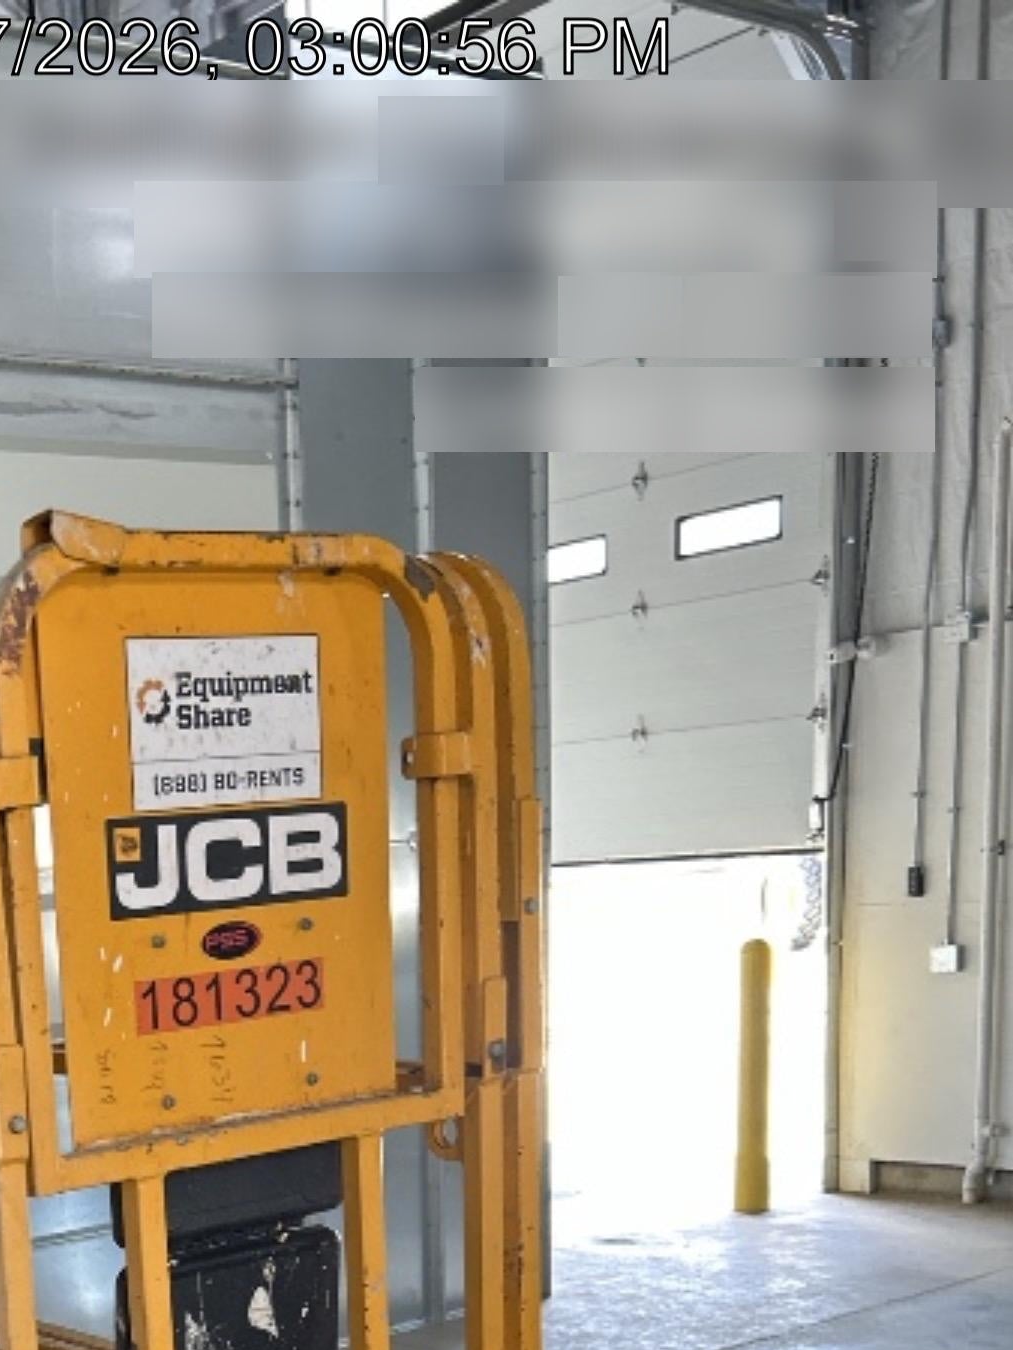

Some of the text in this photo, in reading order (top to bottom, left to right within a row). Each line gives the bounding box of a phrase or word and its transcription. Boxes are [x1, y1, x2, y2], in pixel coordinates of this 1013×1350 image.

[173, 668, 313, 703] Equipment
[175, 703, 252, 730] Share
[115, 811, 343, 911] JCB
[141, 959, 322, 1030] 181323
